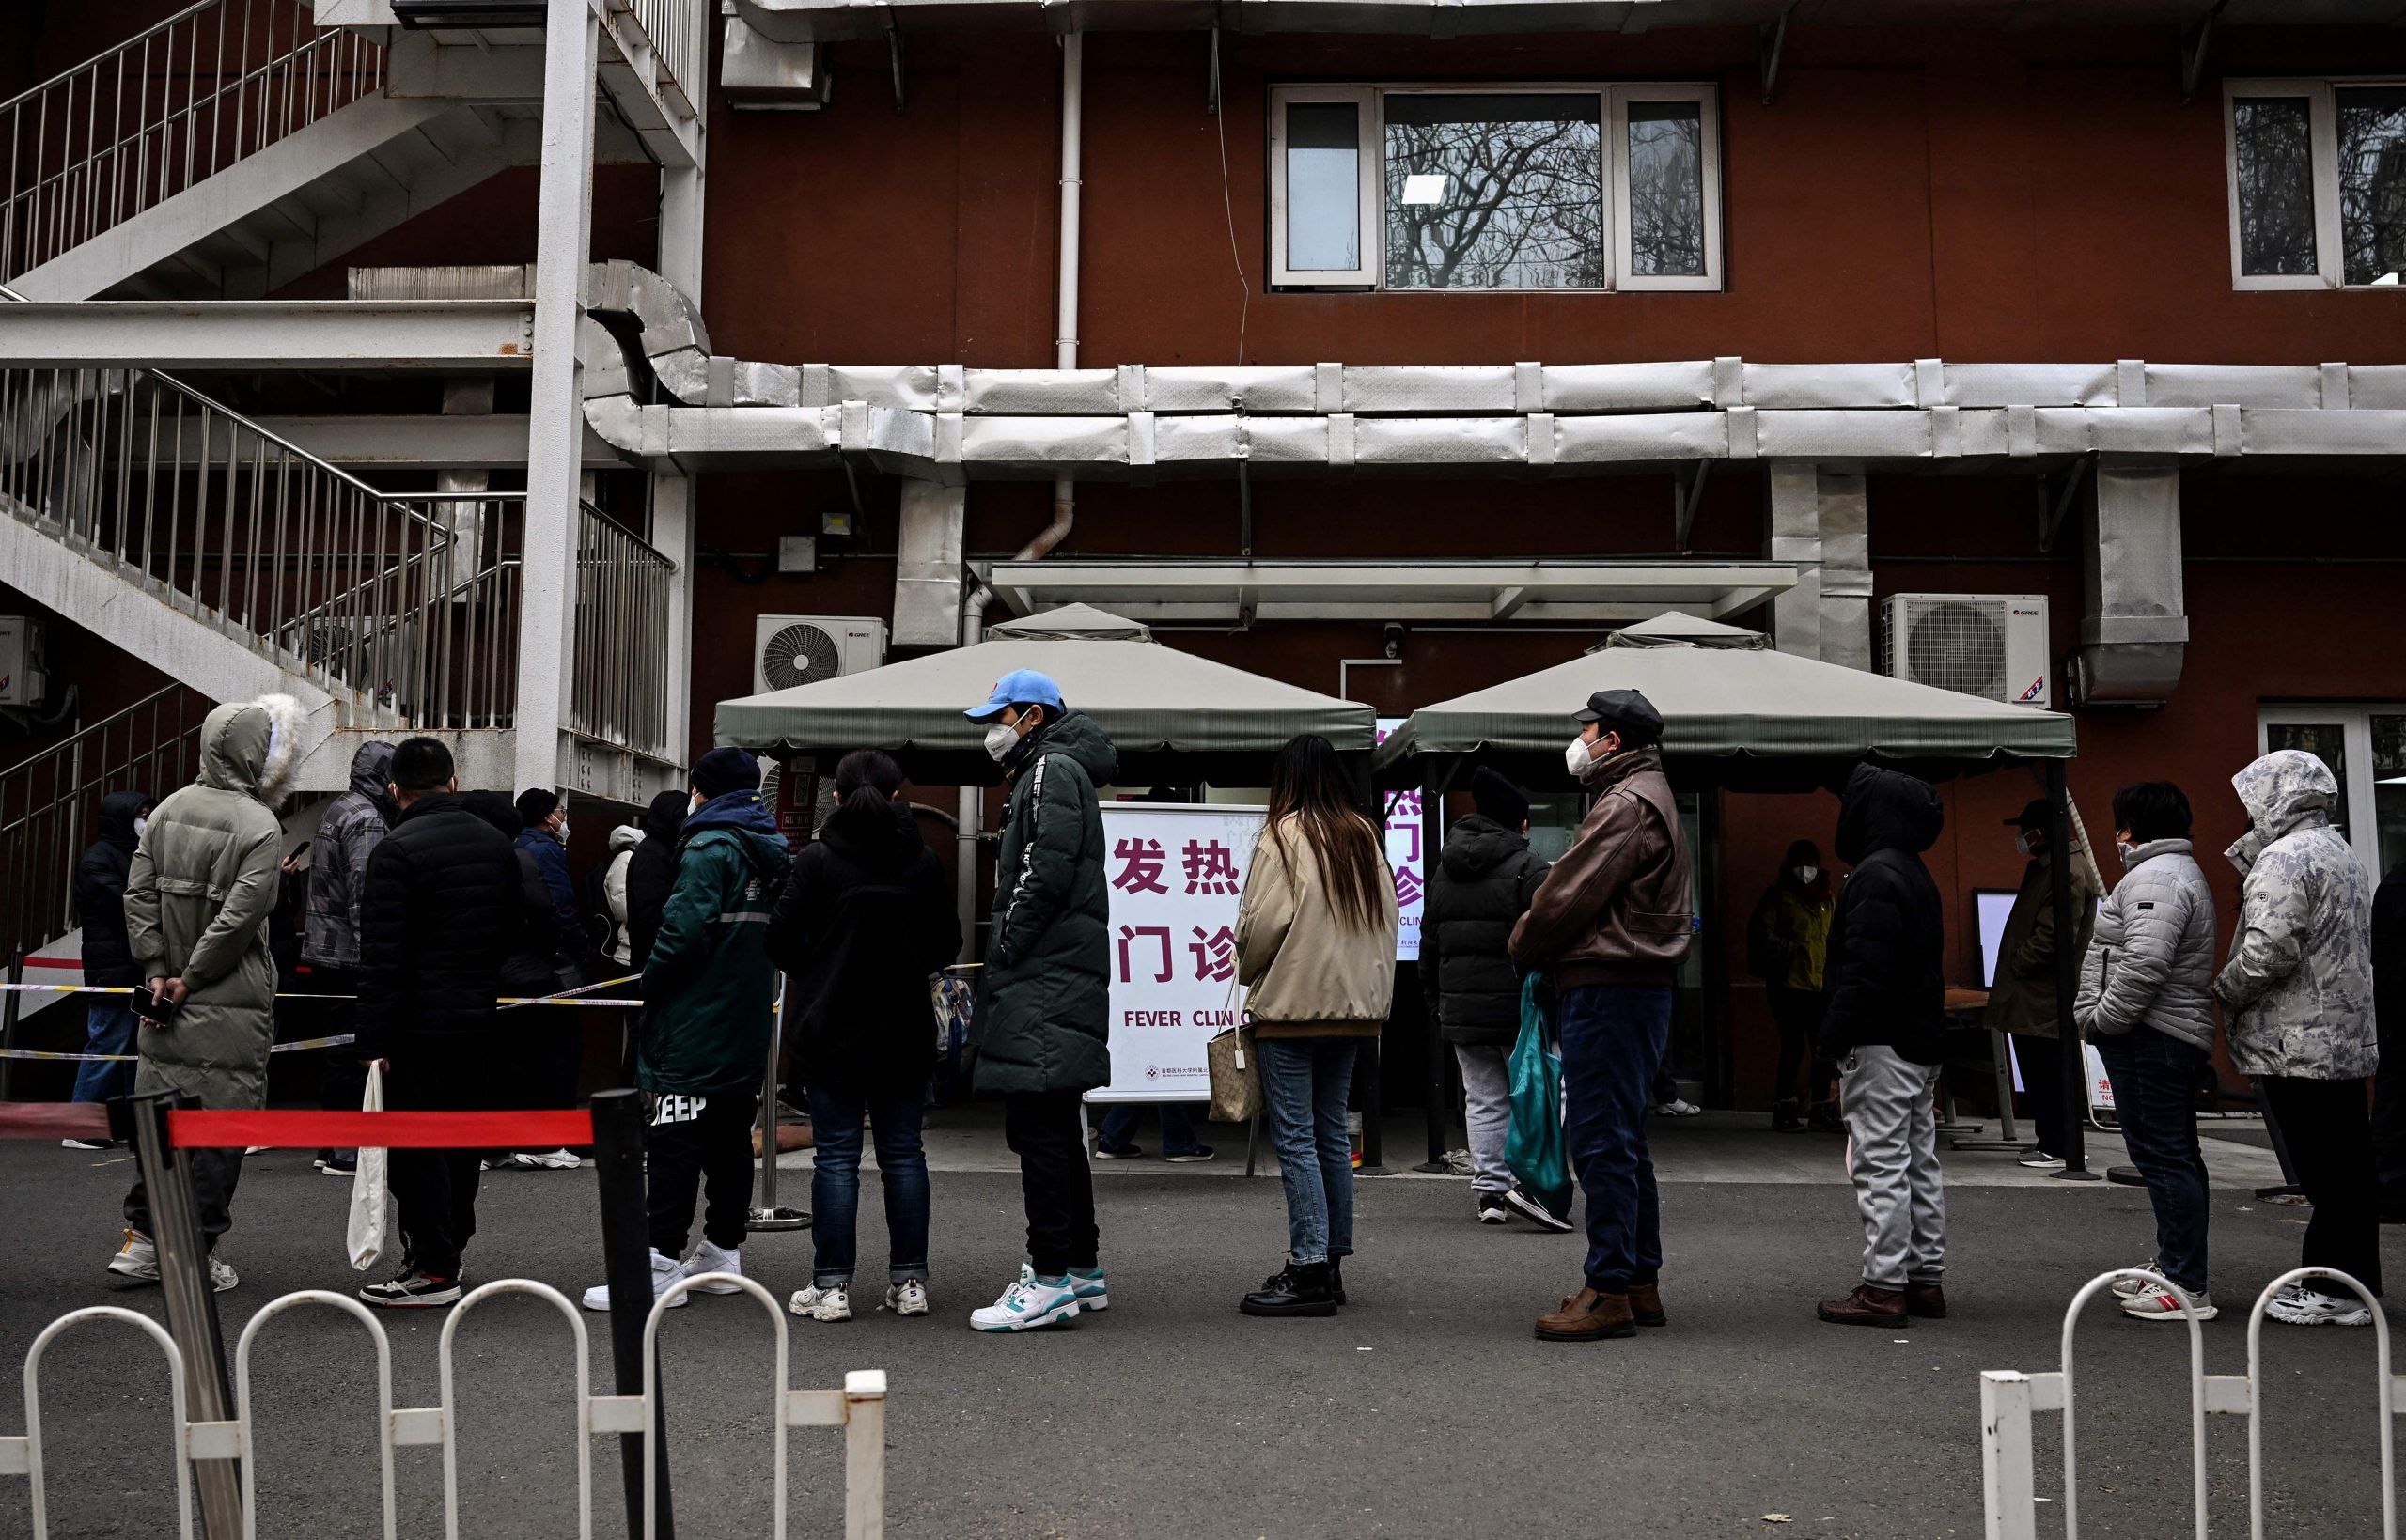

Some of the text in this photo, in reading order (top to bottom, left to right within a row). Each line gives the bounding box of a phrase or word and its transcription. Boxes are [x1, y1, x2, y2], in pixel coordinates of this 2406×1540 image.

[1112, 837, 1241, 895] 发热
[1399, 916, 1422, 926] CLIN
[1117, 924, 1236, 983] 门诊
[1124, 1009, 1251, 1027] FEVER CLINC
